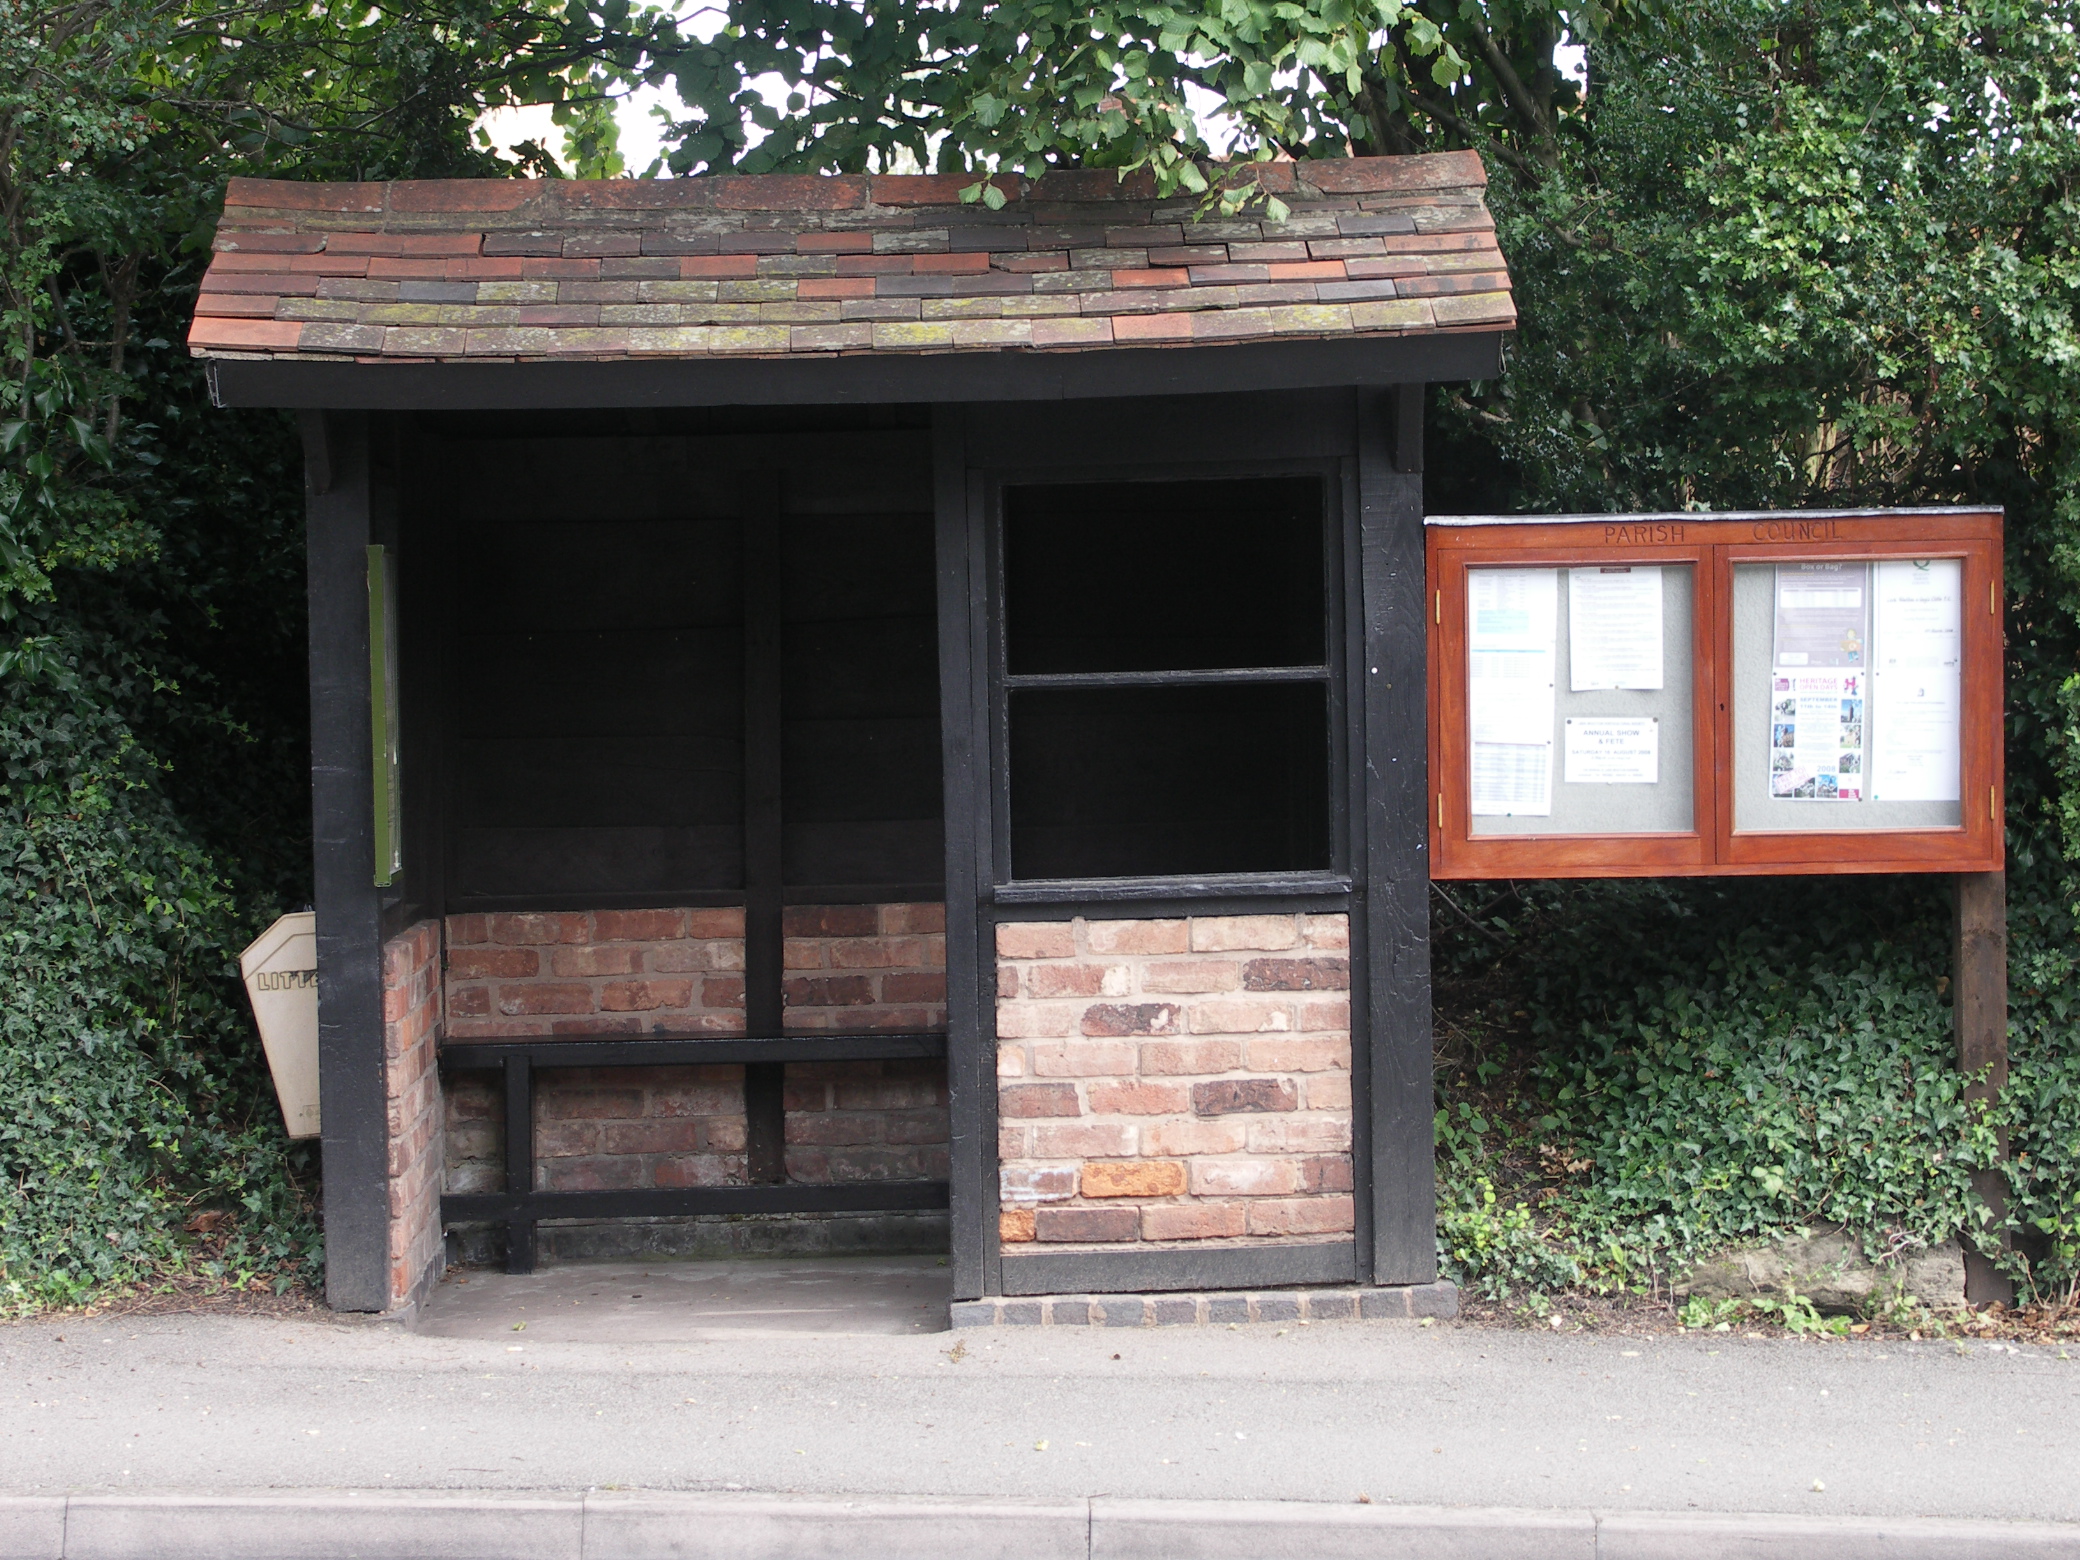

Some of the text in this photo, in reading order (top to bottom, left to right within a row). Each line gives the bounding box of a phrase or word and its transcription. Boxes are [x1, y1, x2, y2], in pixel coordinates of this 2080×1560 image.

[1604, 521, 1842, 544] PARISH COUNCIL
[1801, 562, 1814, 570] Box
